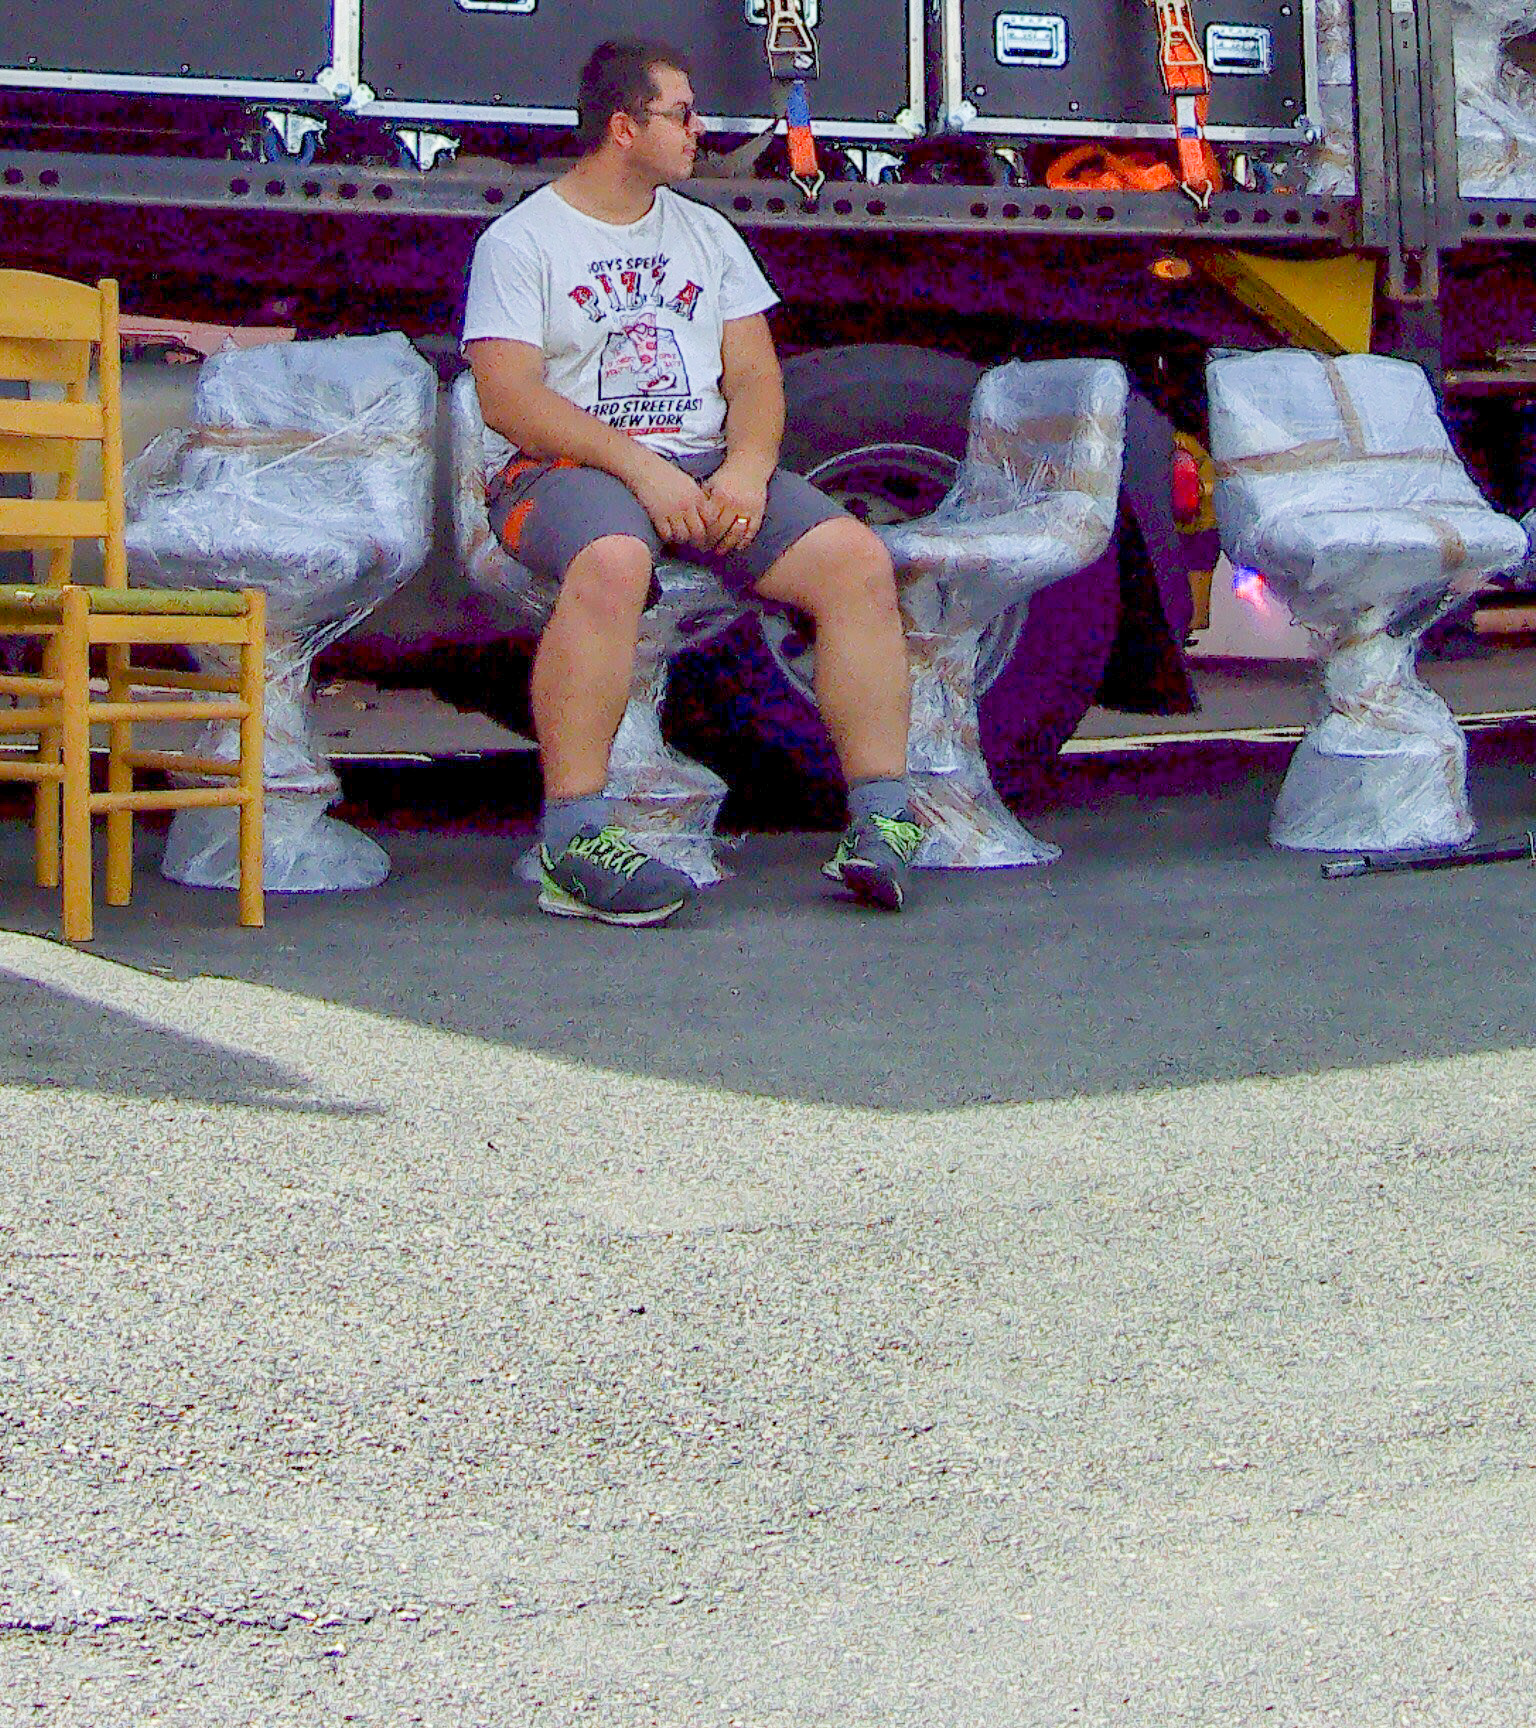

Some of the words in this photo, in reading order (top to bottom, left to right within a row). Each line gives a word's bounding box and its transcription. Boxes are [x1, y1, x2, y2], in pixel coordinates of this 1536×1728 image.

[568, 265, 704, 323] PIZZA
[623, 400, 675, 413] STREET
[675, 398, 703, 412] EAST
[608, 414, 645, 428] NEW
[648, 414, 684, 426] YORK
